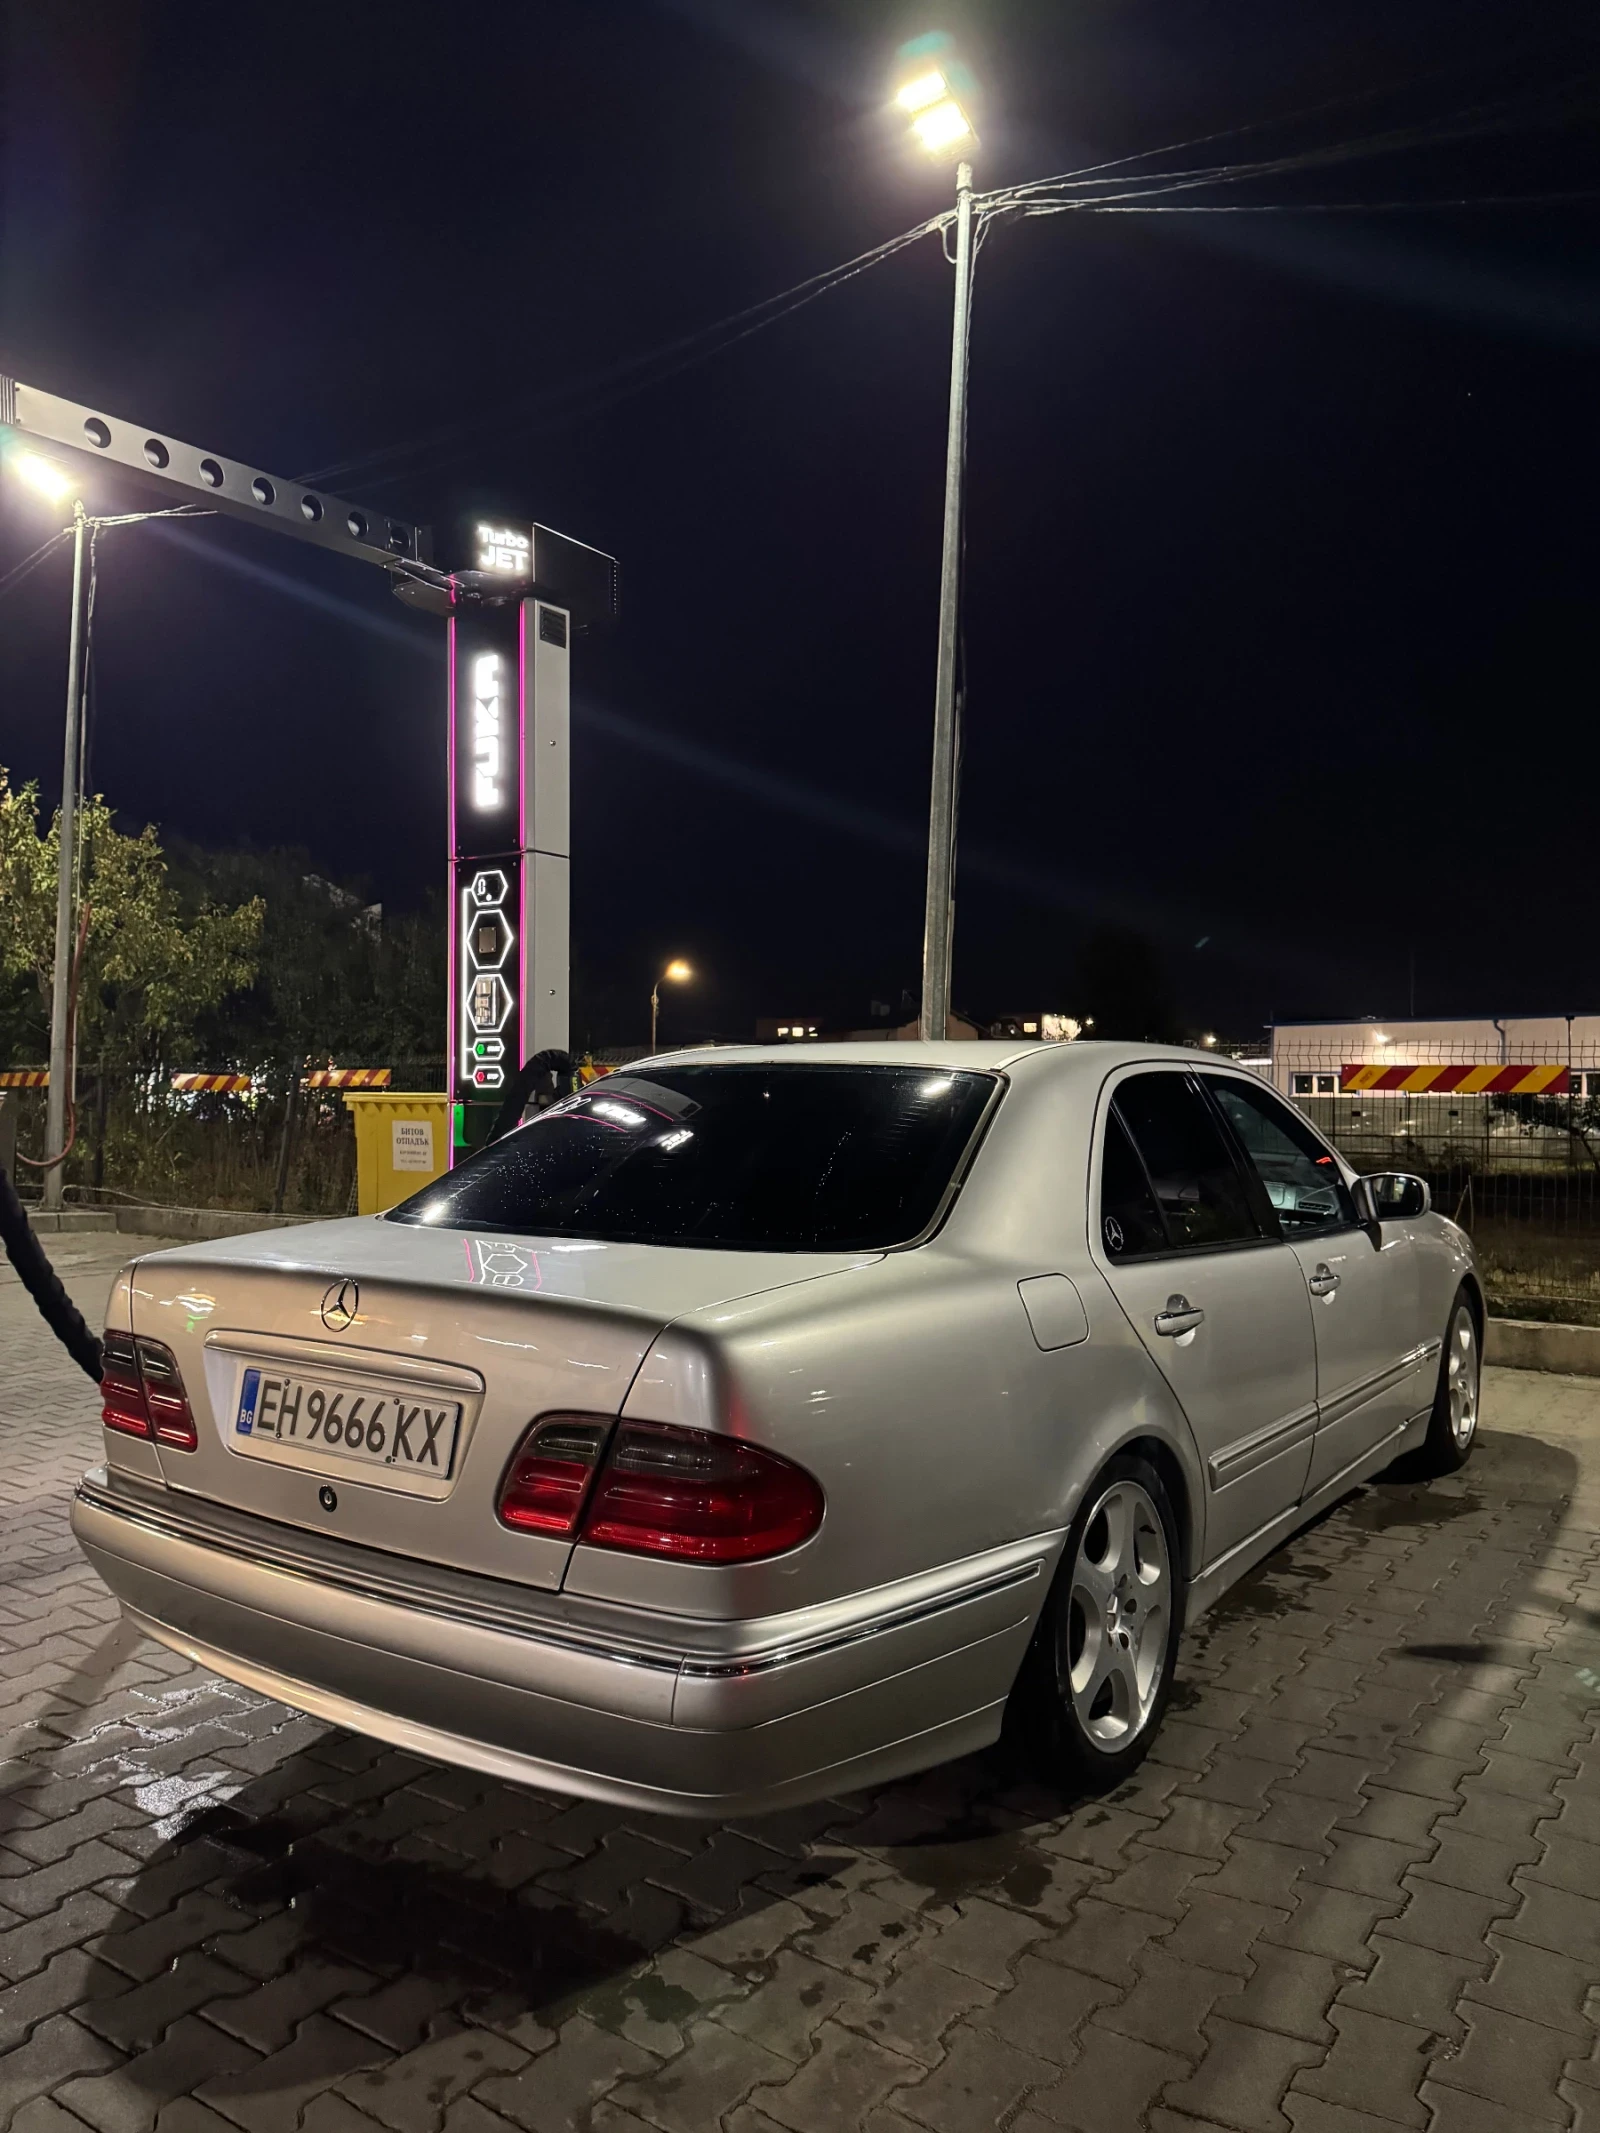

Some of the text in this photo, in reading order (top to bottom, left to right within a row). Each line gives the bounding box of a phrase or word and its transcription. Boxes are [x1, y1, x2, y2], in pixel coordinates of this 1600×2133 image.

[478, 525, 529, 549] Turbo
[479, 545, 529, 571] JET
[401, 1128, 424, 1136] БИТОВ
[396, 1137, 429, 1146] ОТПАДЪК
[240, 1409, 253, 1424] BG
